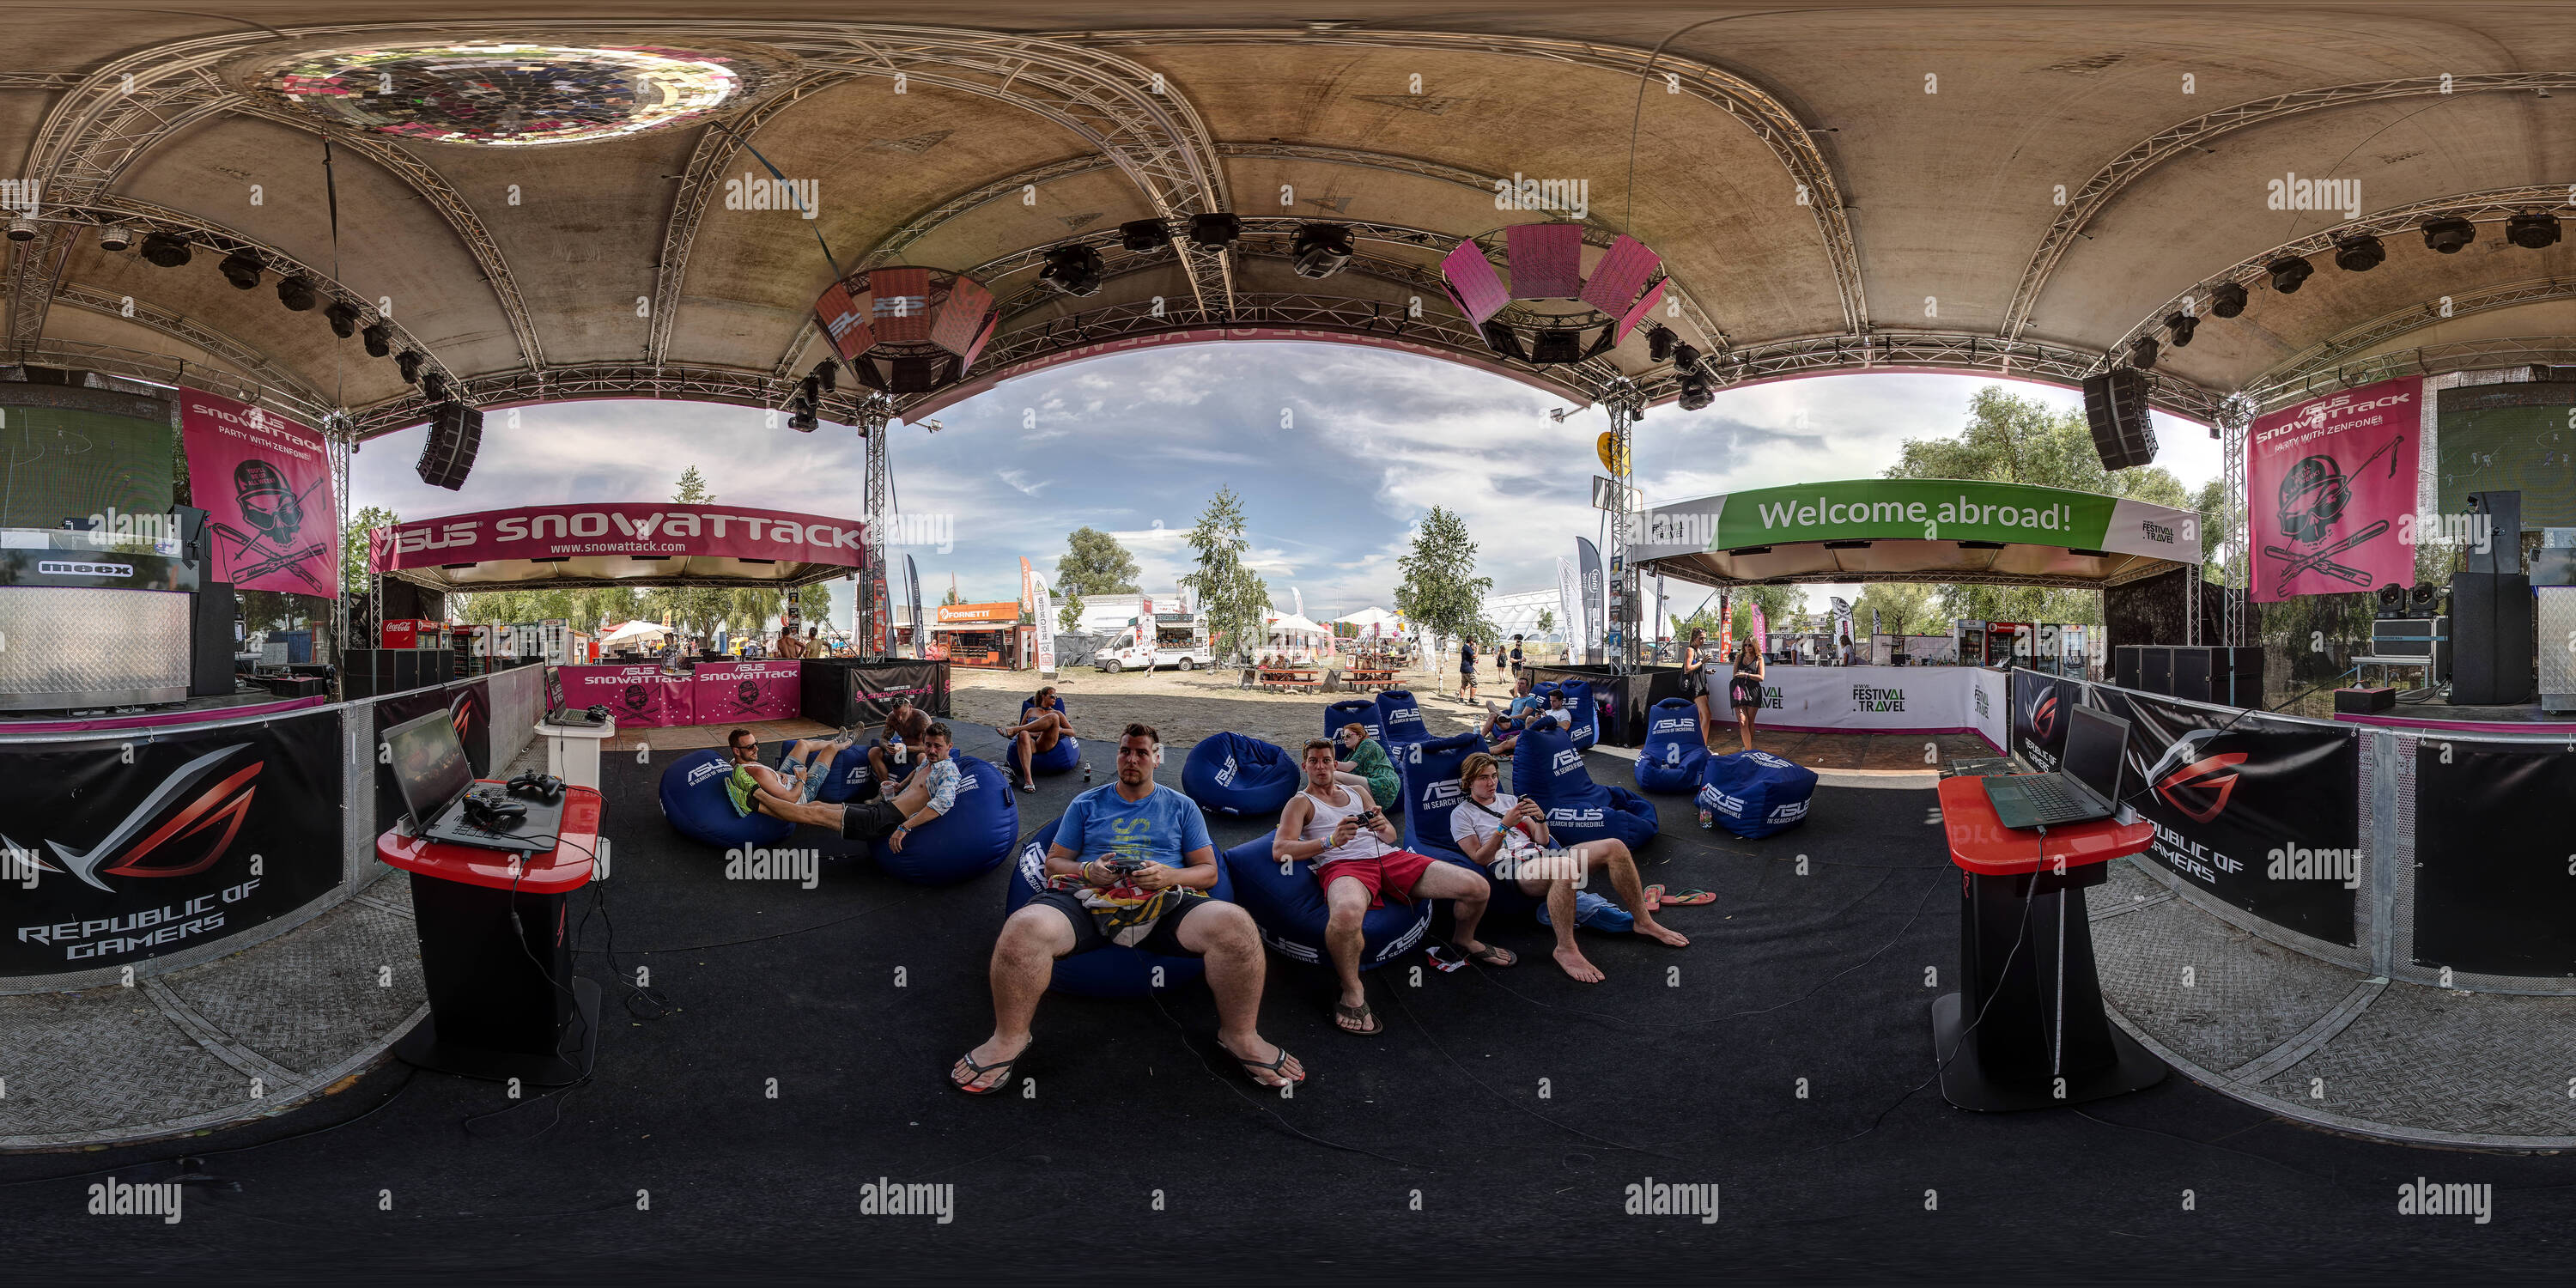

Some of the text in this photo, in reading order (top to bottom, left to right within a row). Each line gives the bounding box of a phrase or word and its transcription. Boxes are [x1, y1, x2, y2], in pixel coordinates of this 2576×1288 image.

[2298, 395, 2351, 419] ASUS
[219, 426, 247, 440] PARTY
[250, 434, 271, 449] WITH
[2301, 429, 2324, 441] WITH
[1759, 495, 2070, 532] Welcome abroad!
[2143, 524, 2174, 536] FESTIVAL
[380, 521, 477, 556] ASUS
[550, 541, 686, 554] www.snowattack.com
[621, 667, 655, 676] ASUS
[734, 664, 765, 672] ASUS
[1853, 689, 1905, 700] FESTIVAL
[1389, 708, 1420, 720] ASUS
[1653, 718, 1695, 731] ASUS
[1571, 725, 1592, 739] ASUS
[2025, 737, 2057, 766] REPUBLIC OF
[2028, 750, 2050, 773] GAMERS
[1214, 754, 1236, 787] ASUS
[1560, 763, 1573, 775] SEARCH
[696, 772, 711, 784] SEARCH
[710, 769, 719, 777] OF
[1431, 799, 1457, 809] SEARCH
[1546, 807, 1604, 821] ASUS
[1717, 805, 1742, 819] INCREDIBLE
[1772, 816, 1791, 824] SEARCH
[2150, 840, 2215, 884] AMERS
[2214, 851, 2245, 873] OF
[18, 878, 260, 945] REPUBLIC OF
[67, 911, 225, 960] GAMERS
[1388, 939, 1418, 958] SEARCH
